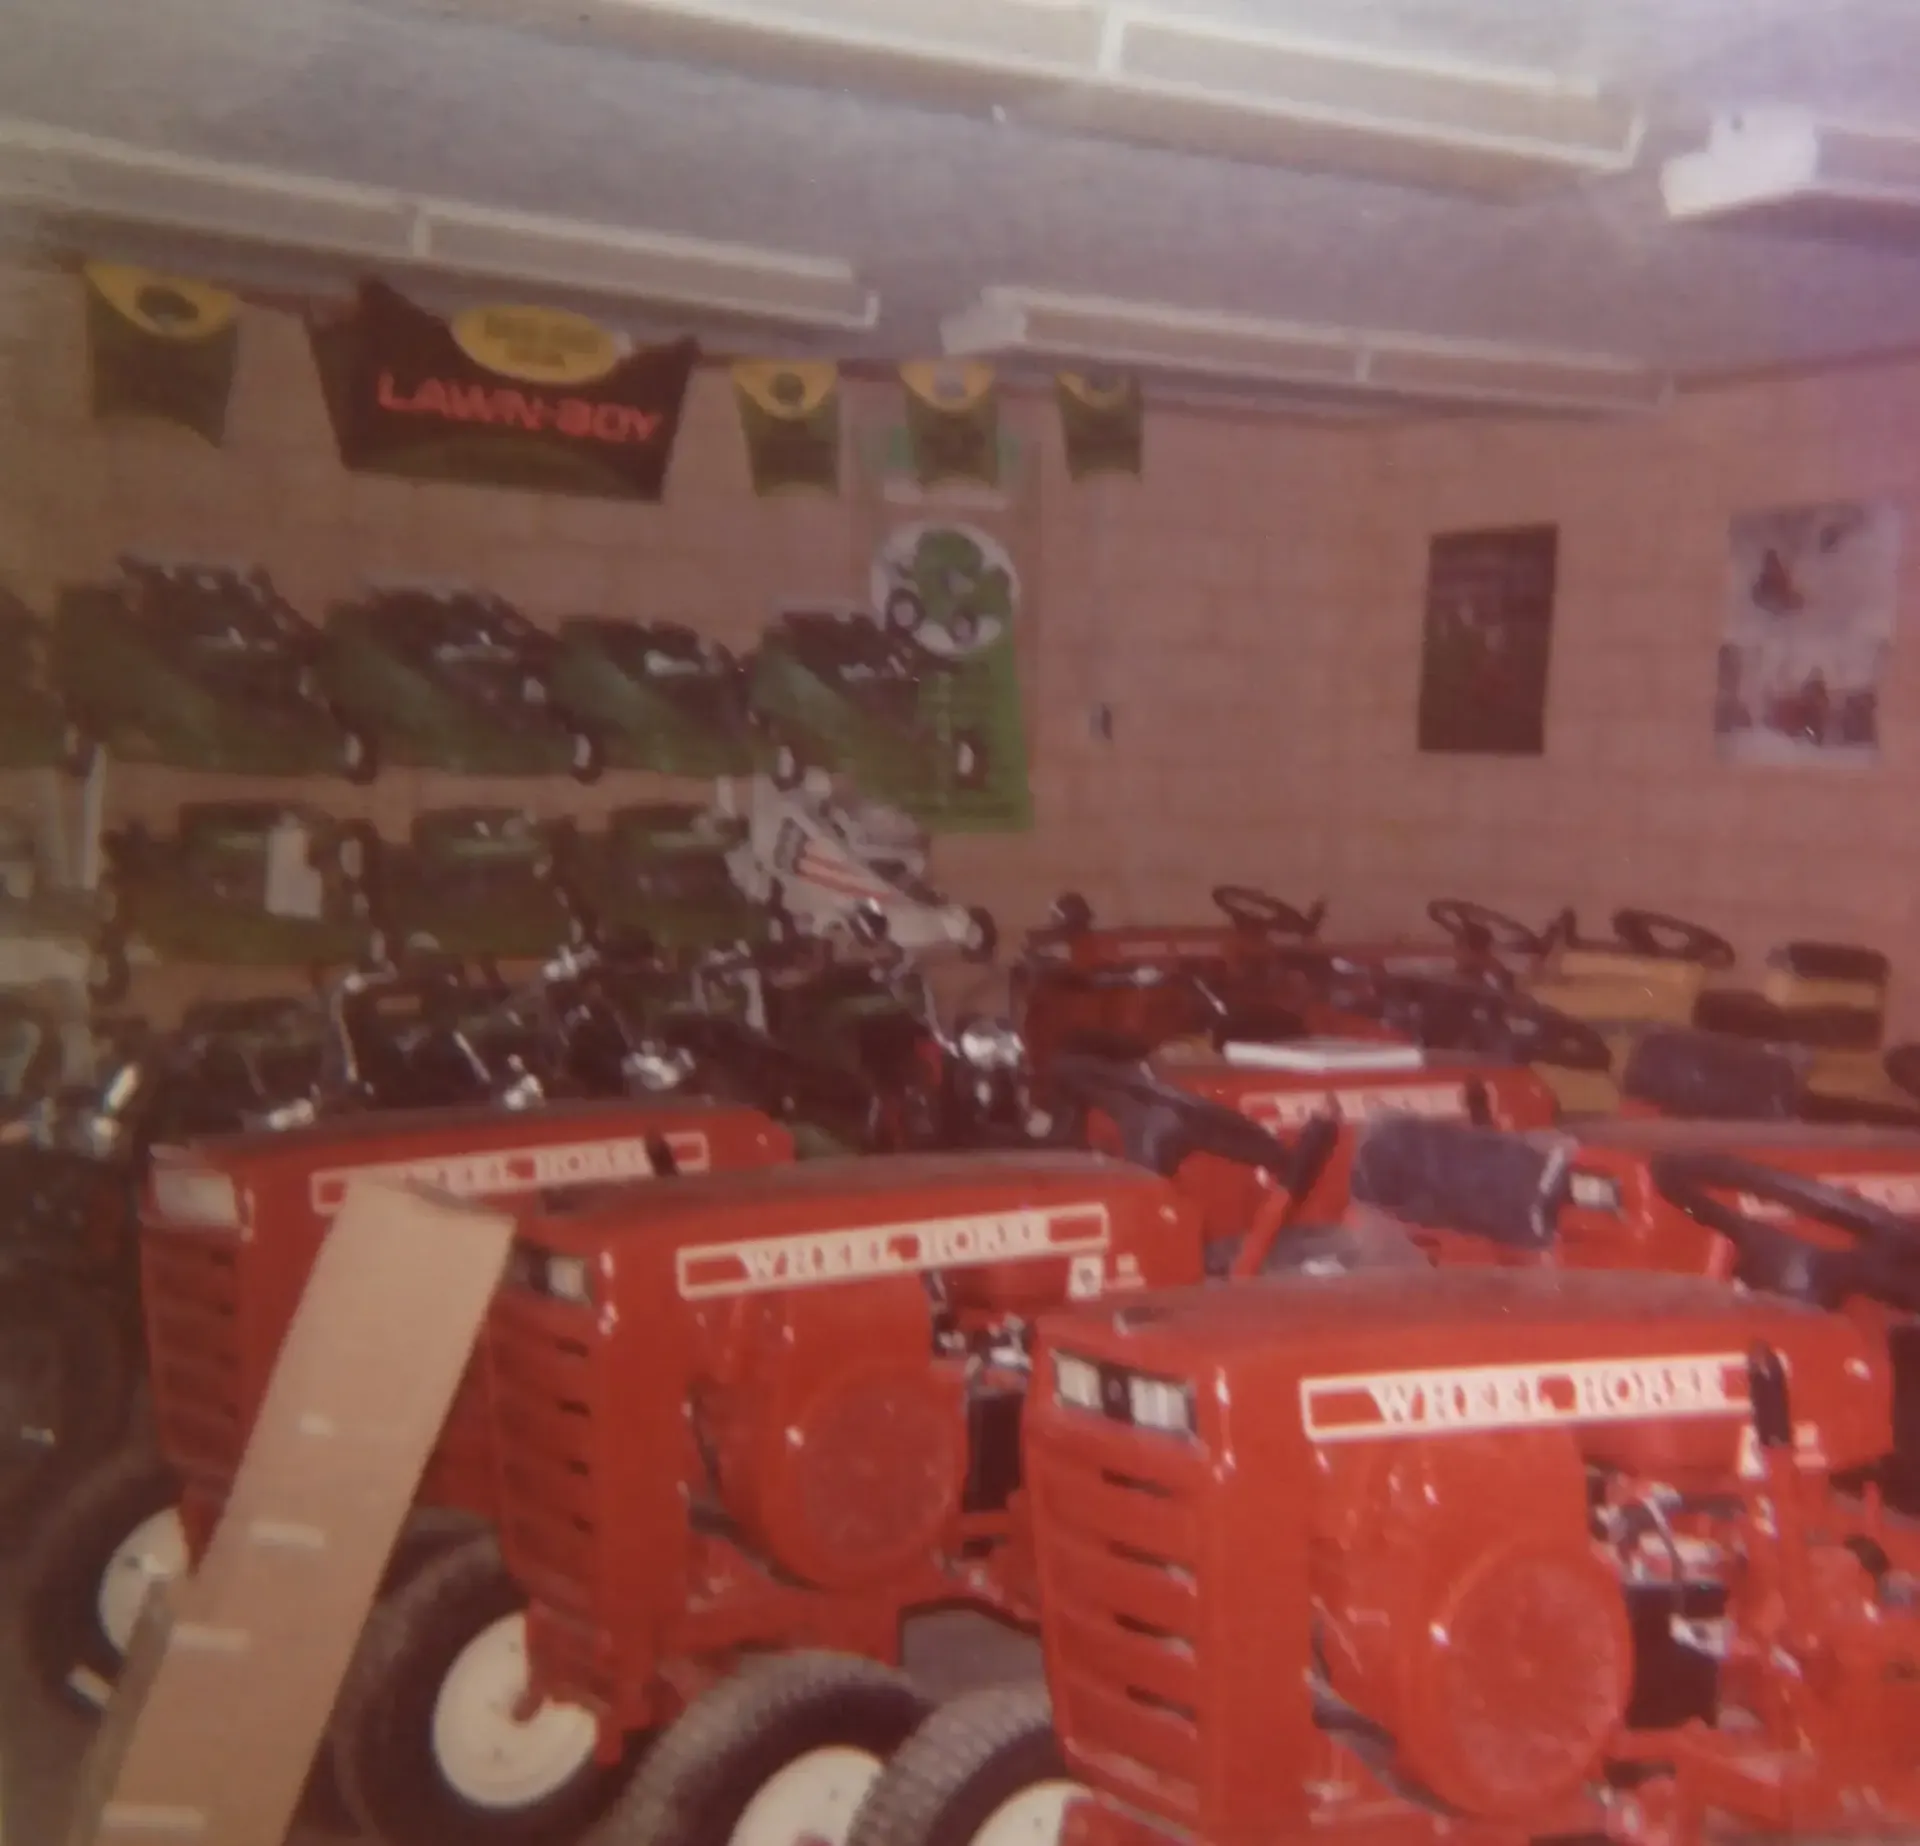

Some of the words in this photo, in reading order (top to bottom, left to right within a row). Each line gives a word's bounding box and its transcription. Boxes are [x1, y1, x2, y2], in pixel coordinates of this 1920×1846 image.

[379, 371, 662, 442] LAWN-BOY
[738, 1233, 901, 1284] WHEEL
[917, 1212, 1048, 1264] HORSE
[1369, 1374, 1557, 1424] WHEEL
[1574, 1363, 1724, 1412] HORSE
